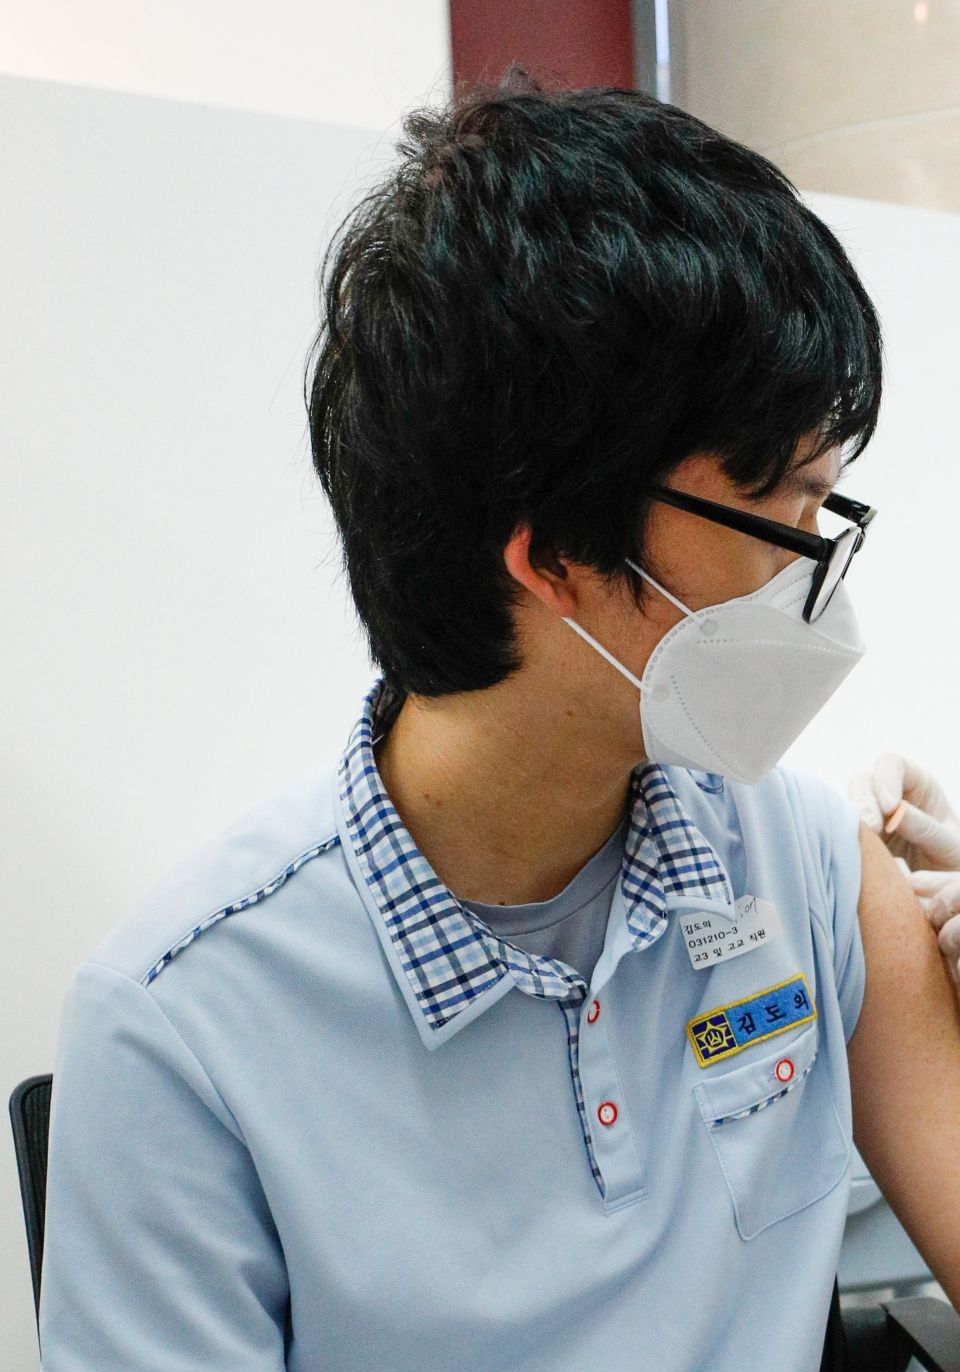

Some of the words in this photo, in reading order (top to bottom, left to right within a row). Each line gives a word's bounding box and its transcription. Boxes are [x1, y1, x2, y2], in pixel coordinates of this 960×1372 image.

[684, 920, 712, 935] 김도의
[688, 926, 739, 949] 031210-3
[693, 952, 709, 963] 고3
[713, 947, 723, 958] 및
[728, 939, 745, 952] 고교
[749, 928, 766, 943] 직원
